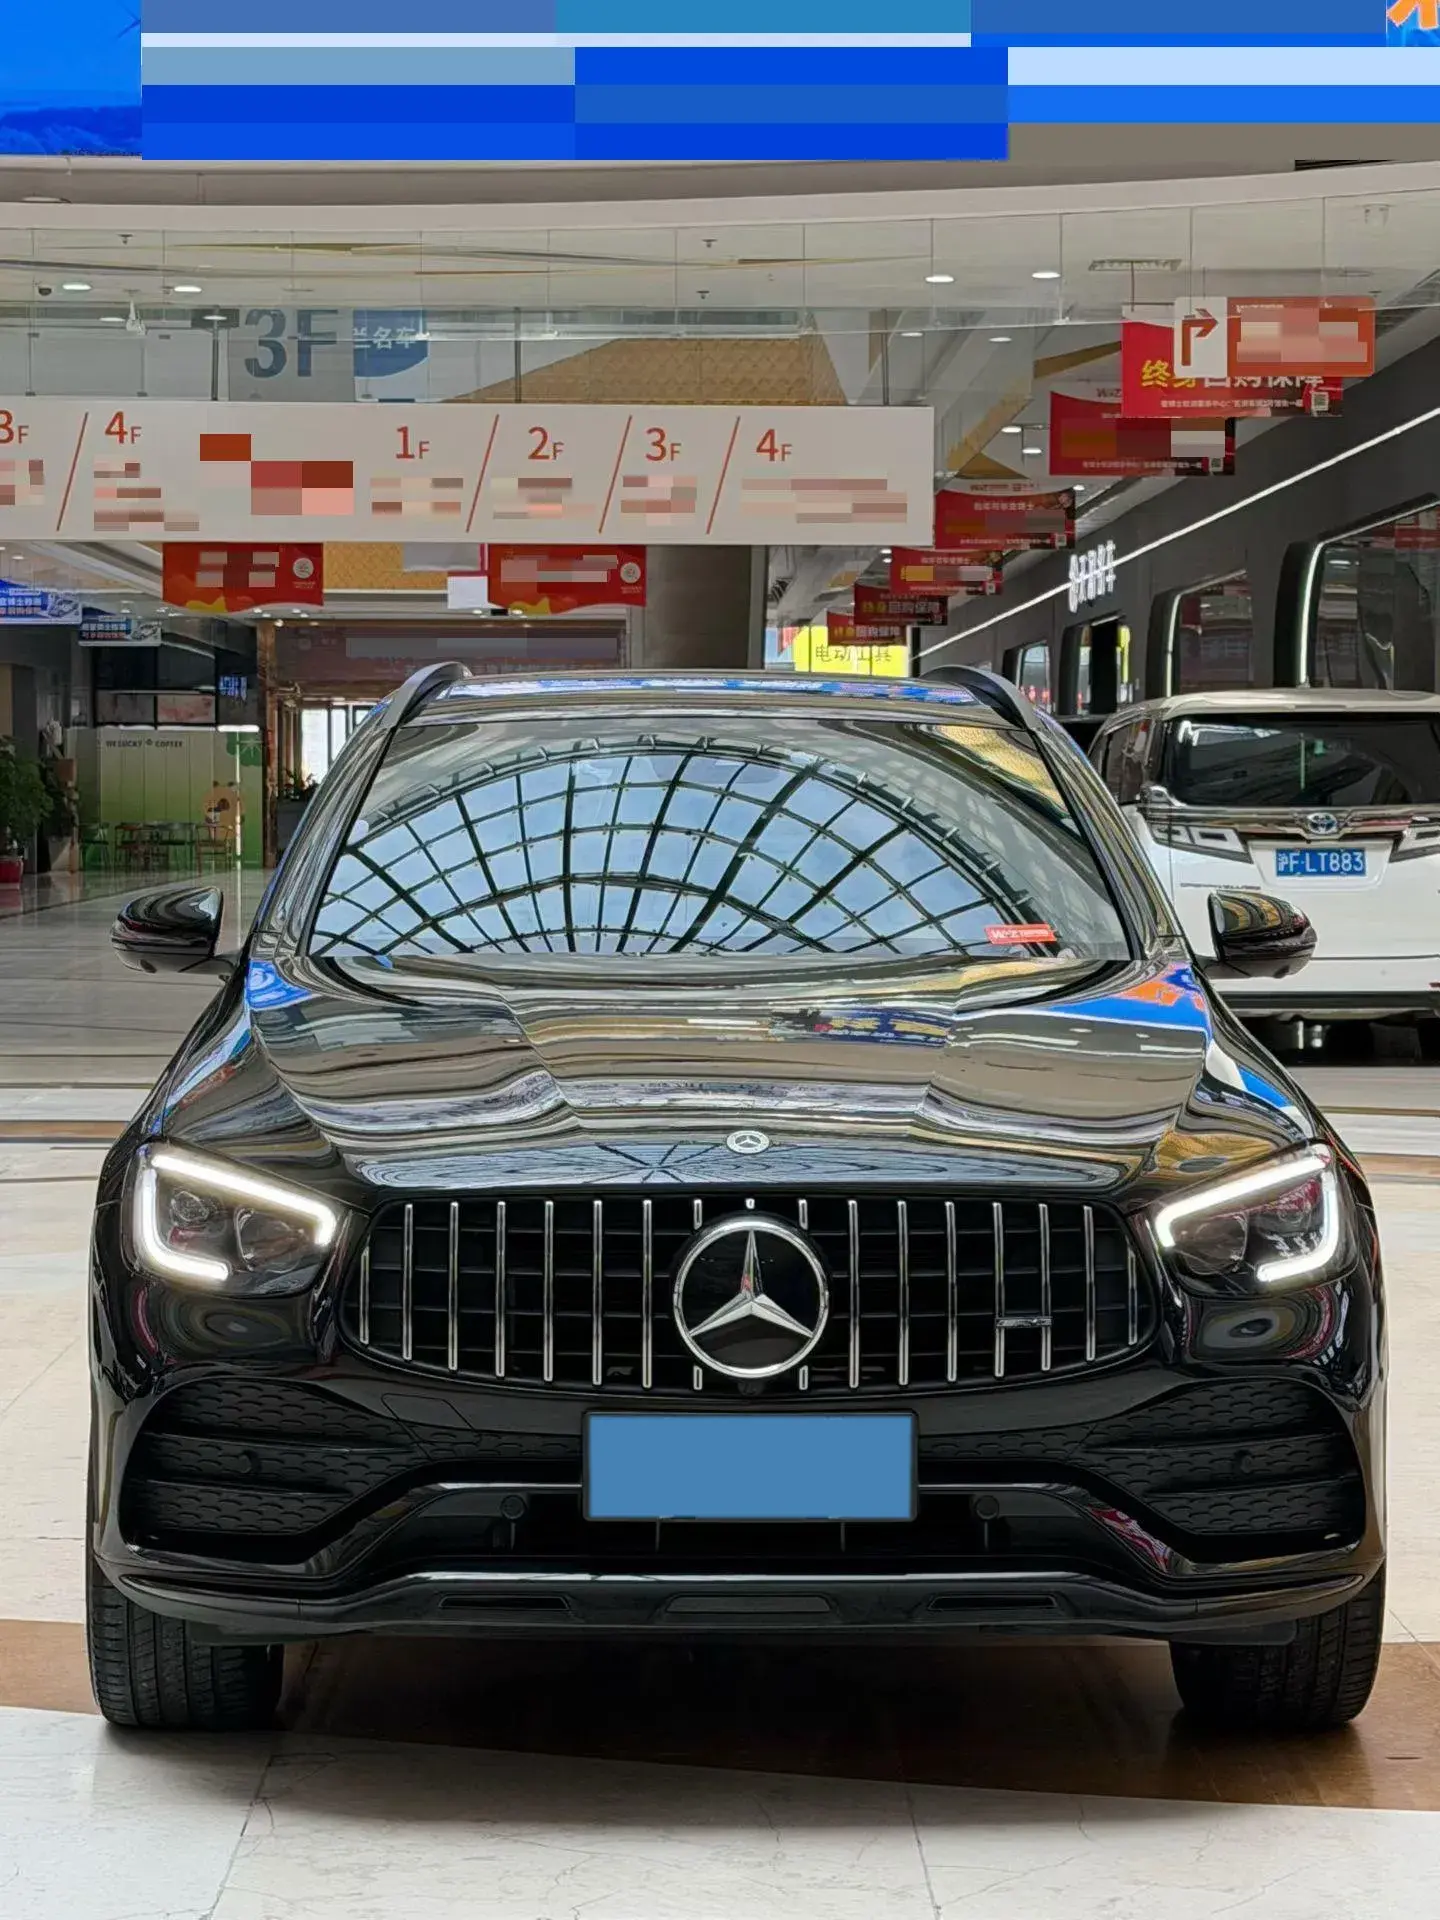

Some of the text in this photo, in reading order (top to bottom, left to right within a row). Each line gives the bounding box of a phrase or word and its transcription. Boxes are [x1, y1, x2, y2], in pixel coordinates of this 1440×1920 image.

[244, 308, 339, 379] 3F
[104, 411, 142, 444] 4F
[395, 426, 430, 460] 1F
[527, 426, 565, 461] 2F
[645, 427, 682, 462] 3F
[755, 428, 793, 462] 4F
